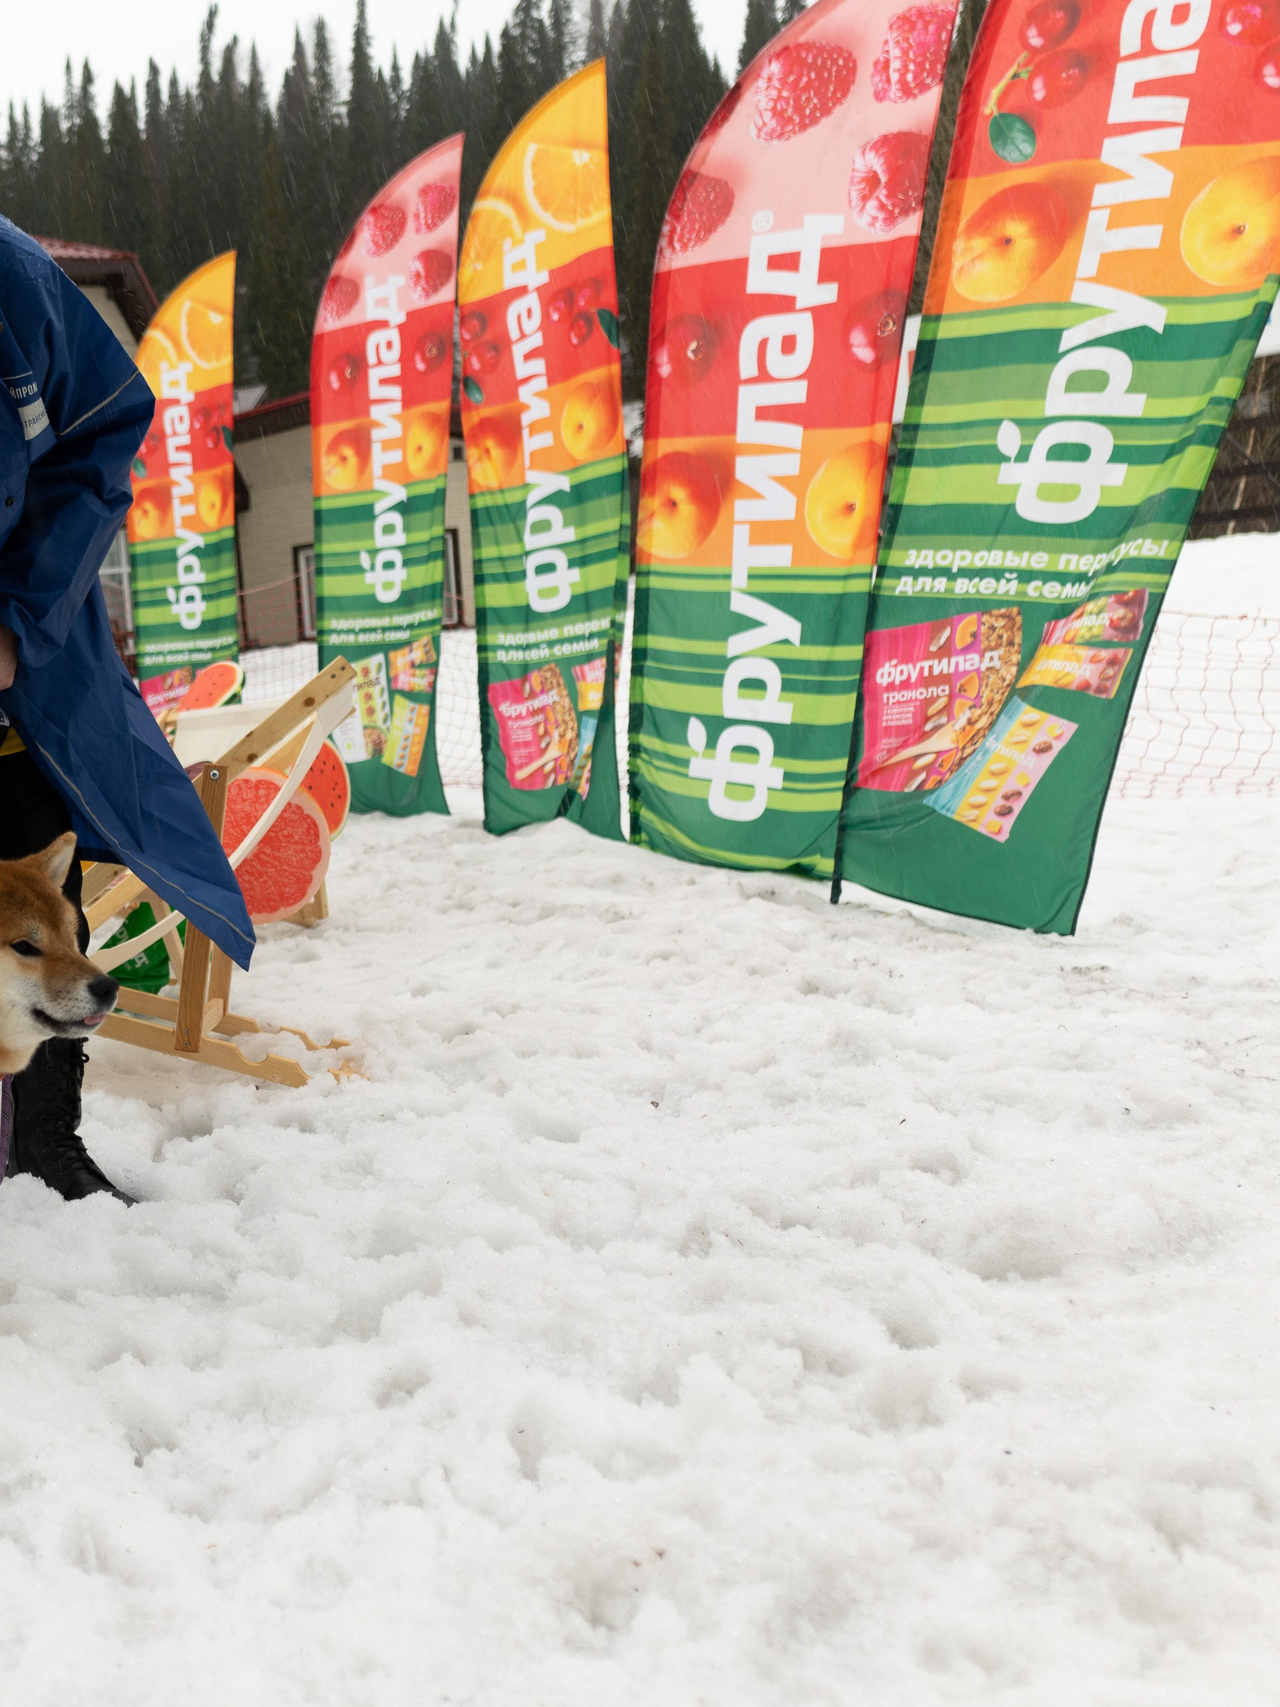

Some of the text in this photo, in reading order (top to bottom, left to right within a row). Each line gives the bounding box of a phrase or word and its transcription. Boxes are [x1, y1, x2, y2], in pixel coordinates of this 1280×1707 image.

[996, 0, 1211, 525] фрутила
[160, 360, 207, 630] фрутилад
[363, 274, 407, 603] фрутилад
[503, 229, 580, 613] фрутилад
[688, 214, 845, 822] фрутилад
[875, 649, 1002, 687] фрутилад
[882, 684, 950, 706] гранола
[895, 575, 948, 596] для
[954, 571, 1019, 596] всей
[904, 549, 1050, 573] здоровые
